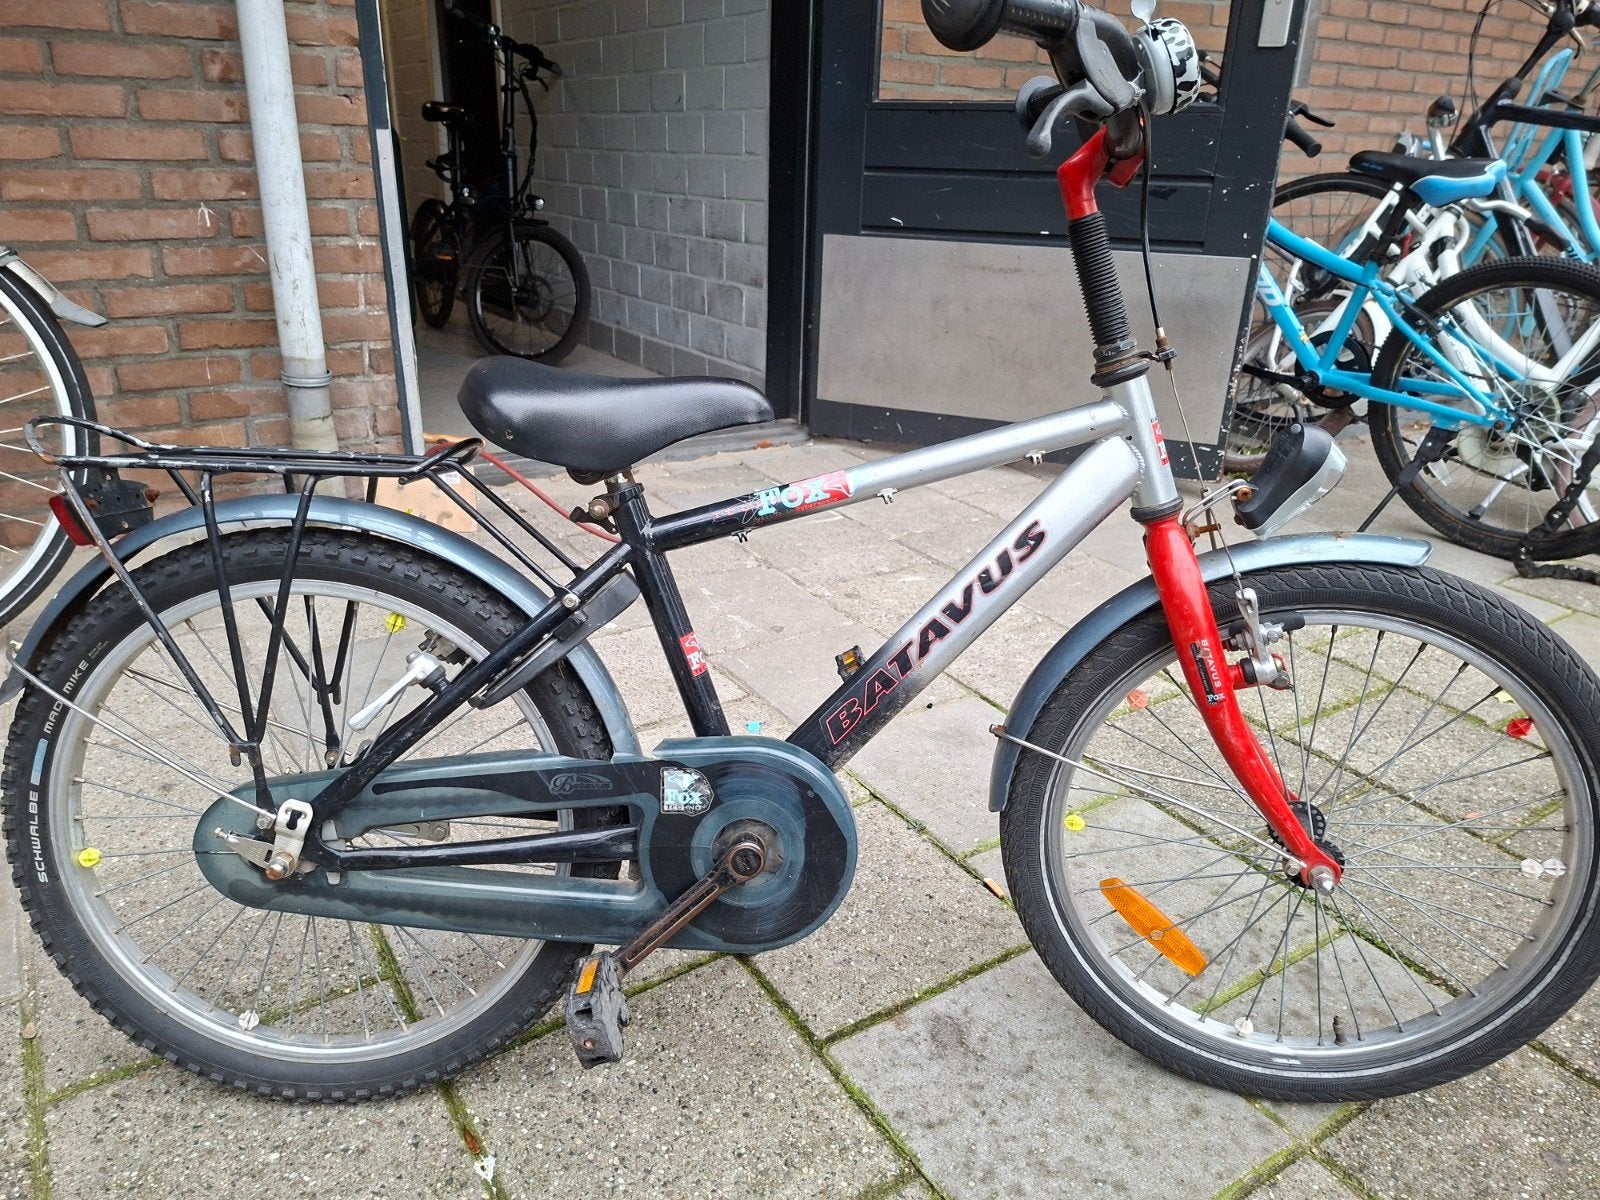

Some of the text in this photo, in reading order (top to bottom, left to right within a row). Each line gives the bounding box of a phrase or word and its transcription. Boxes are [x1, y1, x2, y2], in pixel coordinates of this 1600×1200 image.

[754, 480, 831, 515] FOX
[824, 519, 1048, 746] BATAVUS
[29, 659, 89, 882] SCHWALBE MAD MIKE
